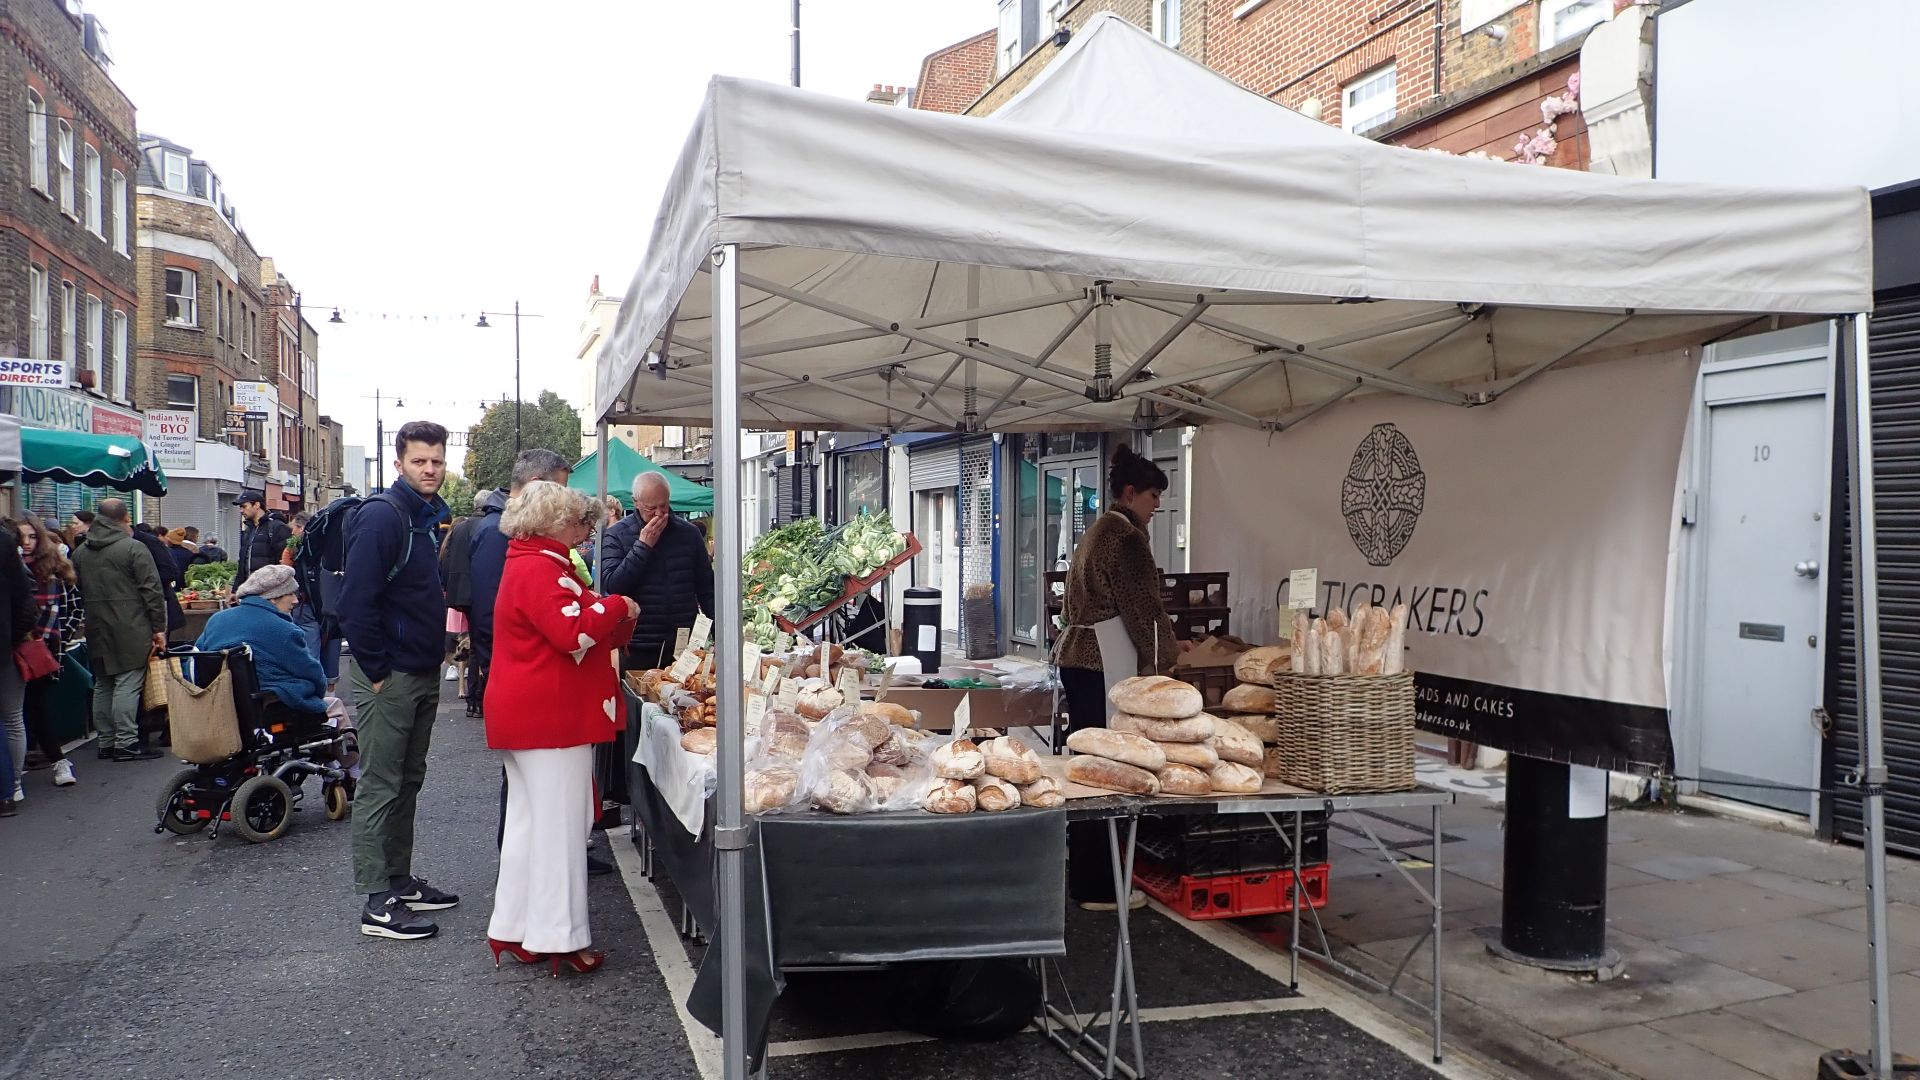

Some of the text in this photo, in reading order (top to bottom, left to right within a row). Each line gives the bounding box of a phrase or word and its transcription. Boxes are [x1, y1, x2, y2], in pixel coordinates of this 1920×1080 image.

[0, 361, 62, 375] SPORTS
[21, 386, 66, 426] INDIAN
[66, 397, 89, 432] VEG
[148, 413, 190, 424] Indian Veg
[160, 423, 187, 434] BYO
[160, 441, 181, 449] Ginger
[1753, 445, 1771, 462] 10
[1276, 577, 1488, 637] CTICBAKERS
[1445, 692, 1469, 708] AND
[1474, 696, 1514, 718] CAKES
[1415, 710, 1471, 731] akers.co.uk
